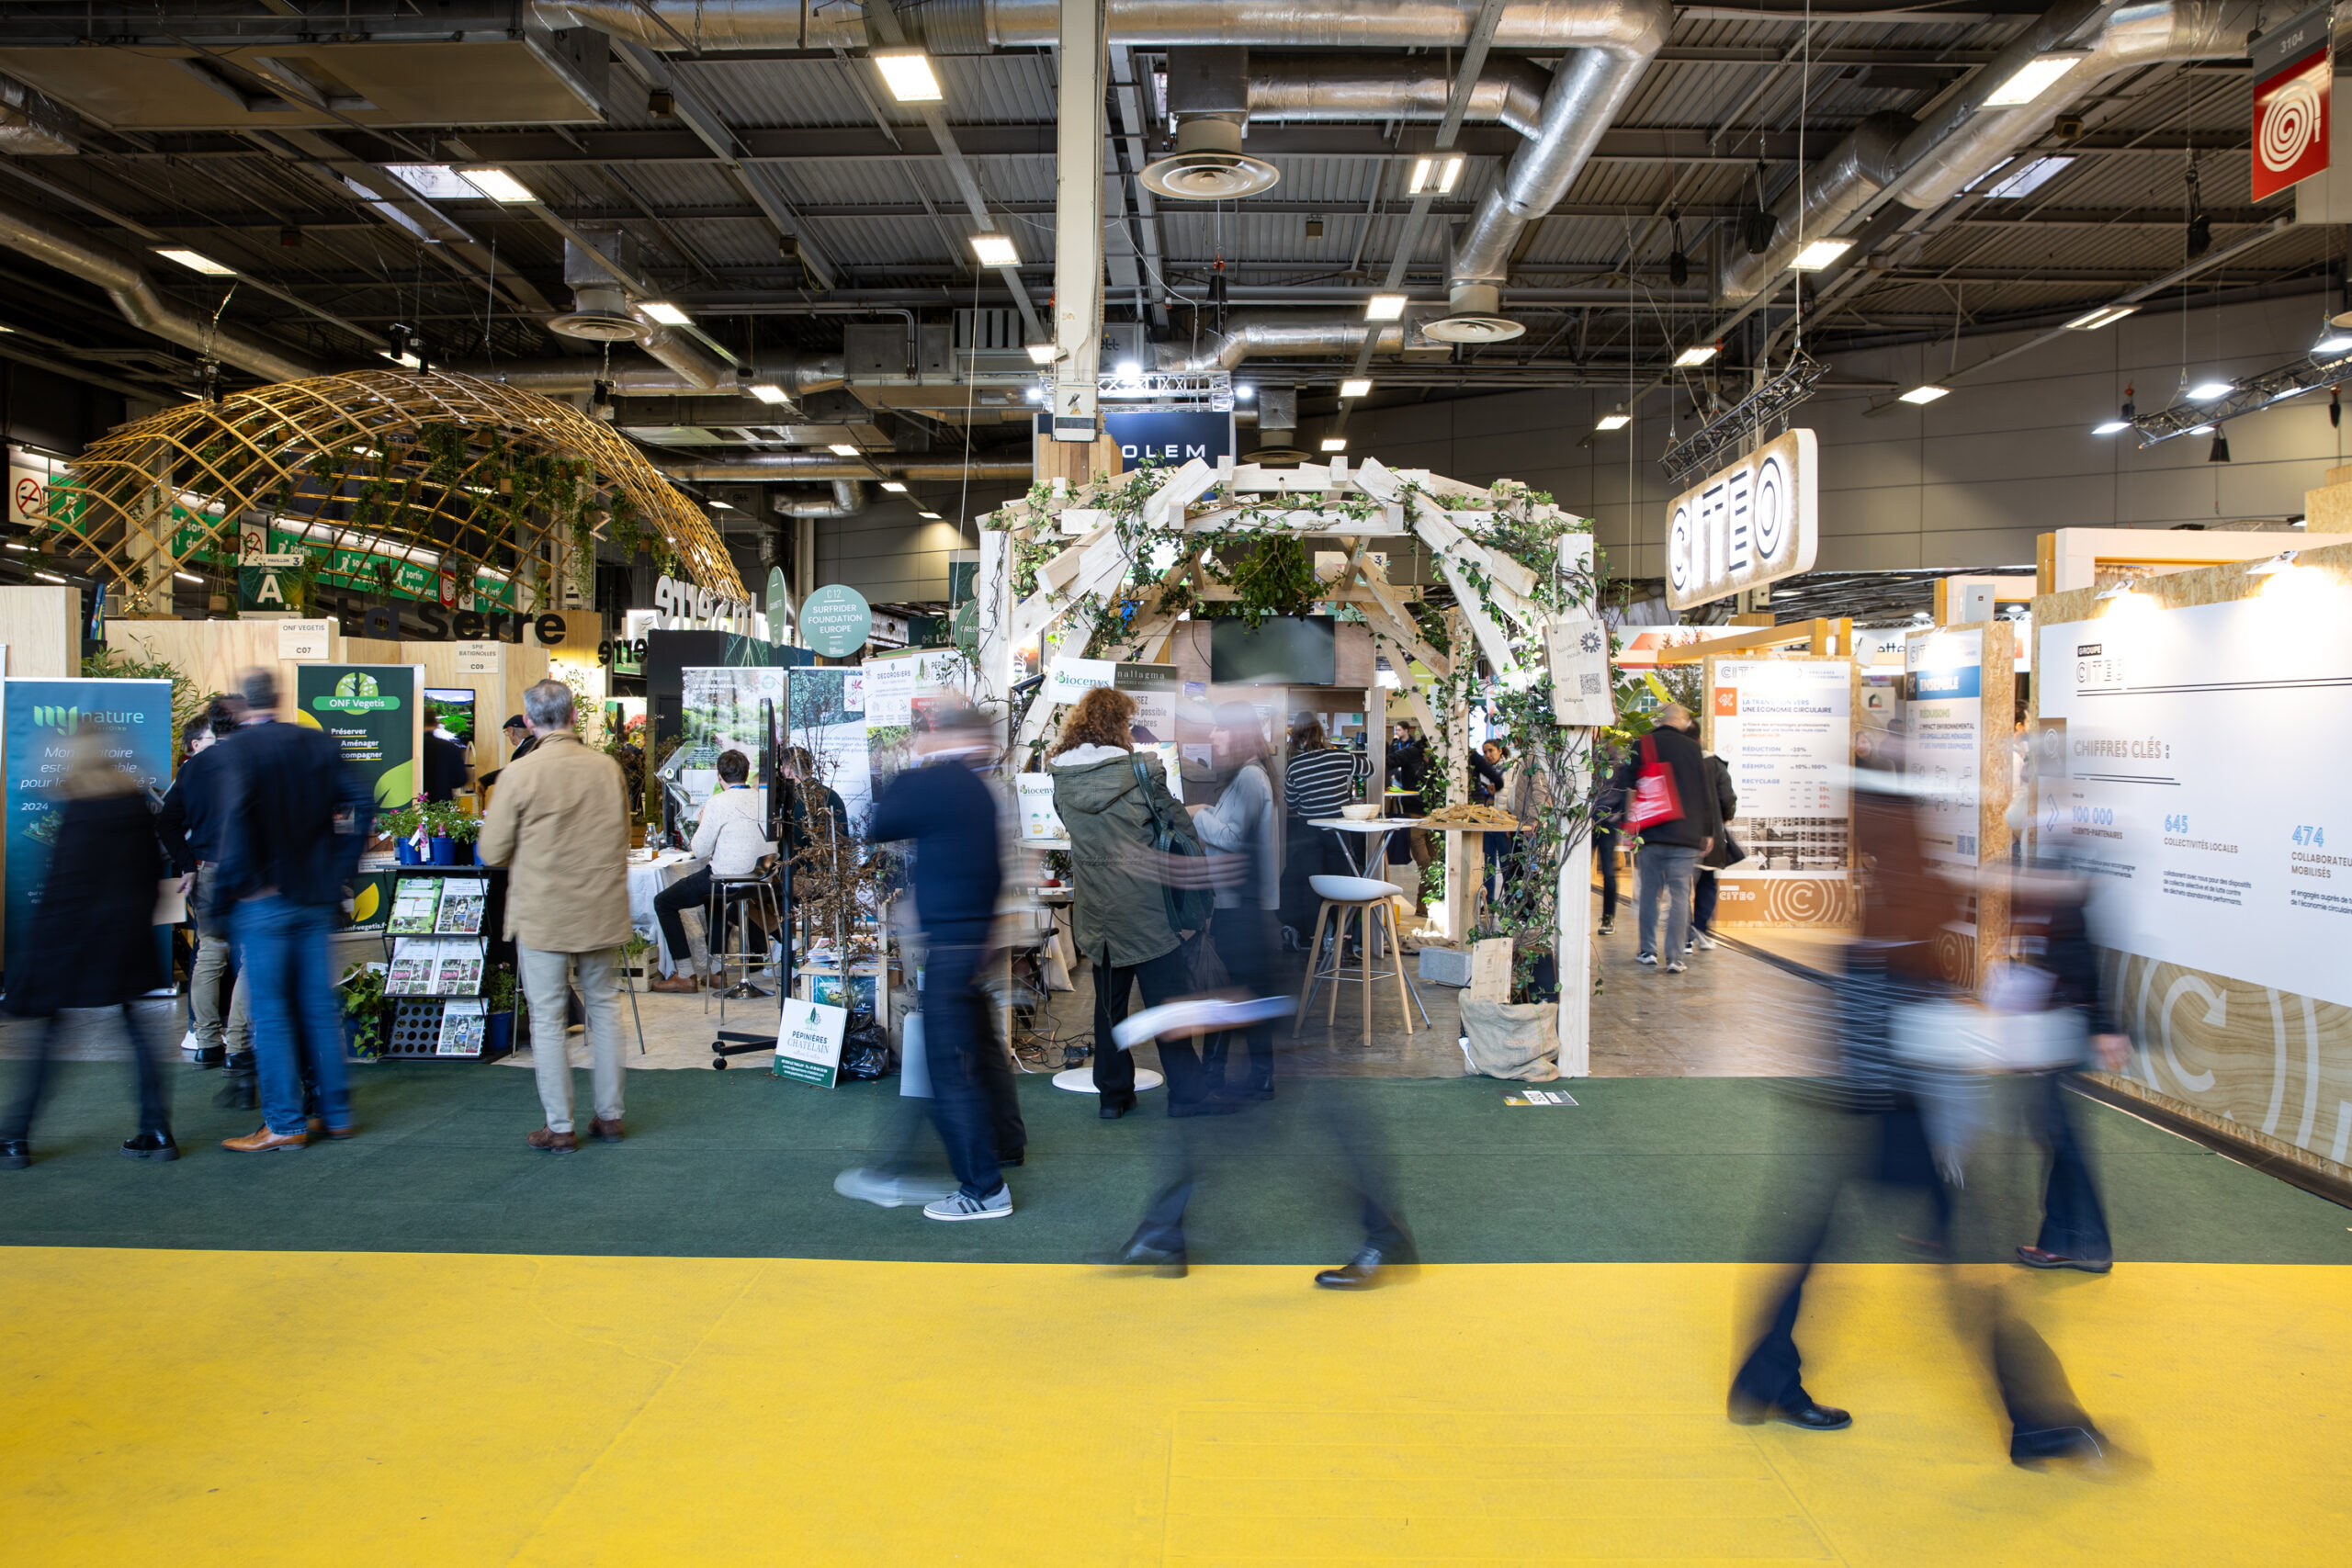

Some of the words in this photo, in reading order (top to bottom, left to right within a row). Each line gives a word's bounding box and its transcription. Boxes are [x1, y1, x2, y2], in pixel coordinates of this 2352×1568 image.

[2280, 29, 2304, 53] 3104
[1122, 445, 1205, 457] OLEM
[1669, 457, 1783, 592] CITEO
[293, 557, 300, 566] 3
[405, 570, 424, 581] sortie
[257, 574, 284, 604] A
[414, 585, 437, 598] seours
[813, 604, 856, 614] SURFRIDER
[418, 601, 567, 645] Serre
[808, 615, 863, 624] FOUNDATION
[820, 625, 852, 634] EUROPE
[2078, 645, 2102, 656] GROUPE
[1117, 670, 1165, 680] nallagma
[330, 699, 350, 707] ONF
[352, 699, 385, 709] Vegetis
[82, 710, 144, 724] nature
[341, 739, 379, 749] Aménager
[2074, 739, 2128, 758] CHIFFRES
[2132, 736, 2162, 759] CLÉS
[340, 751, 382, 761] compagner
[20, 778, 51, 790] pour
[21, 802, 49, 811] 2024
[2073, 806, 2090, 823] 100
[2092, 807, 2113, 826] 000
[2165, 814, 2188, 833] 645
[2292, 825, 2324, 848] 474
[2164, 837, 2209, 850] COLLECTIVITÉS
[2210, 842, 2238, 853] LOCALES
[2291, 864, 2332, 878] MOBILISÉS
[1719, 891, 1756, 901] CITEO
[2297, 890, 2320, 900] engagés
[2321, 893, 2340, 904] auprès
[792, 1031, 828, 1044] PÉPINIÈRES
[787, 1038, 830, 1055] CHATELAIN
